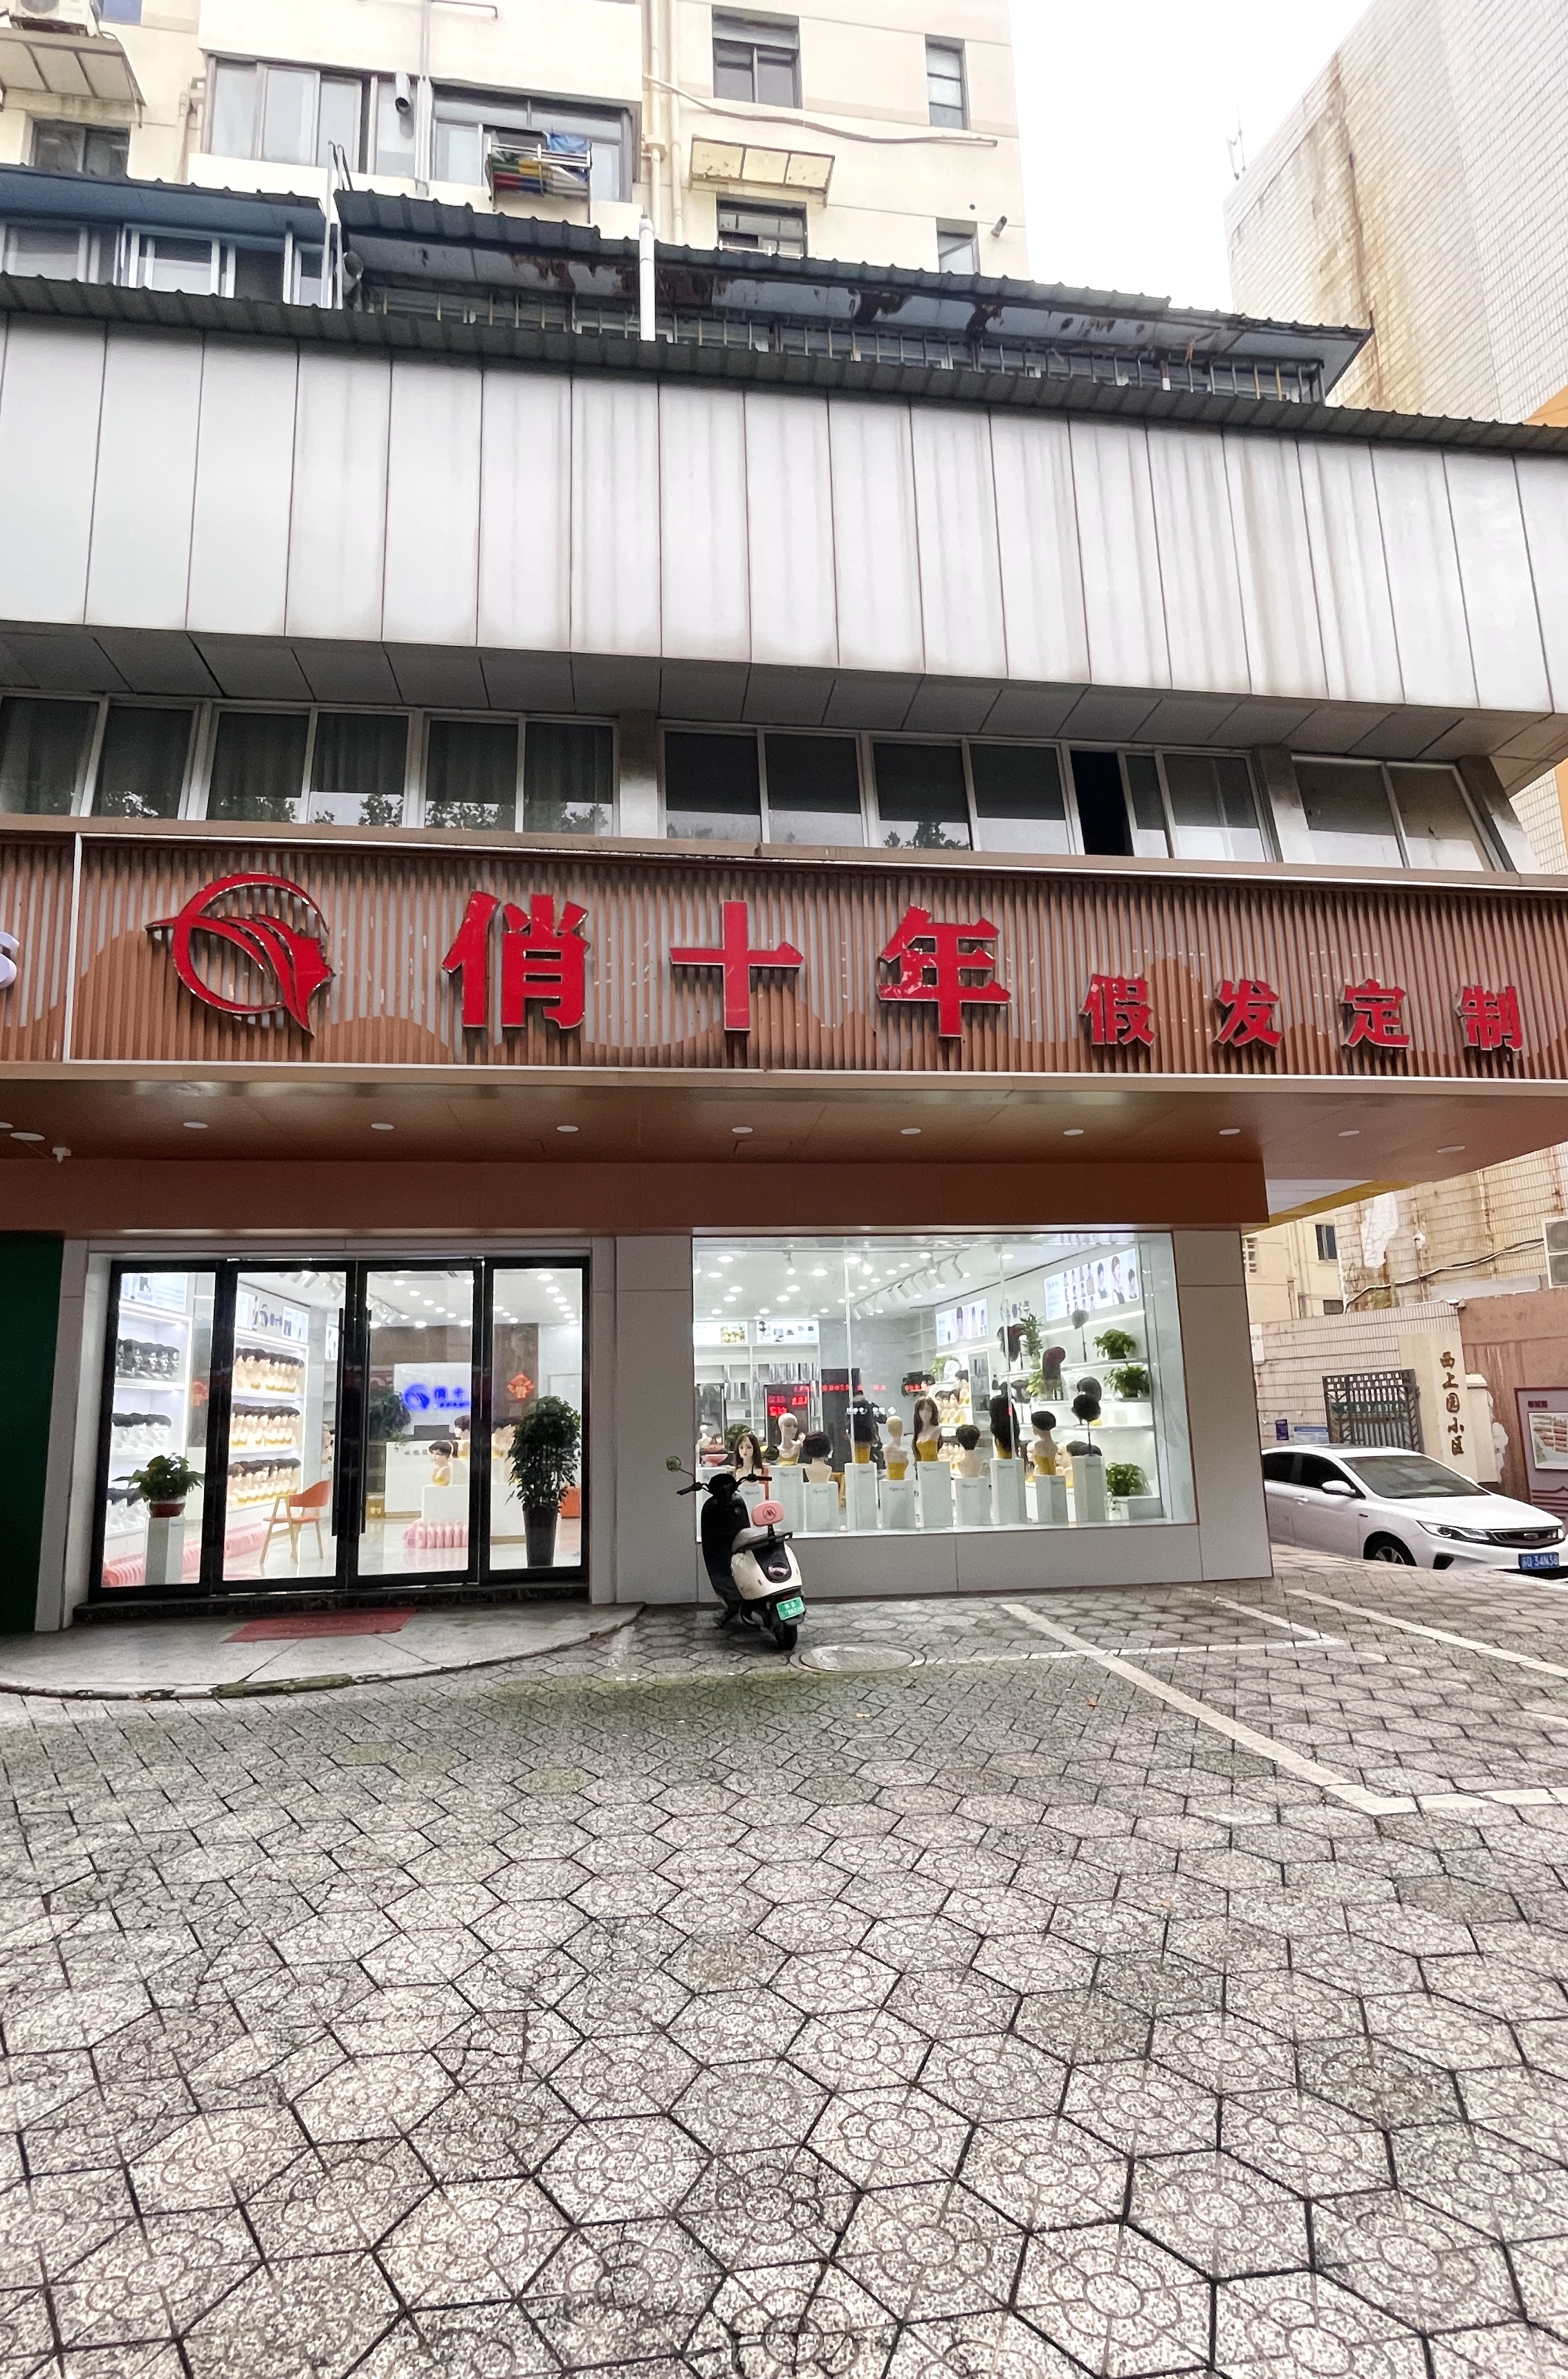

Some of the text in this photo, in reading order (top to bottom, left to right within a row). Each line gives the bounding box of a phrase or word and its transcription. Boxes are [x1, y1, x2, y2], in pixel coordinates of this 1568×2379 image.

[441, 891, 1523, 1051] 俏十年 假发定制
